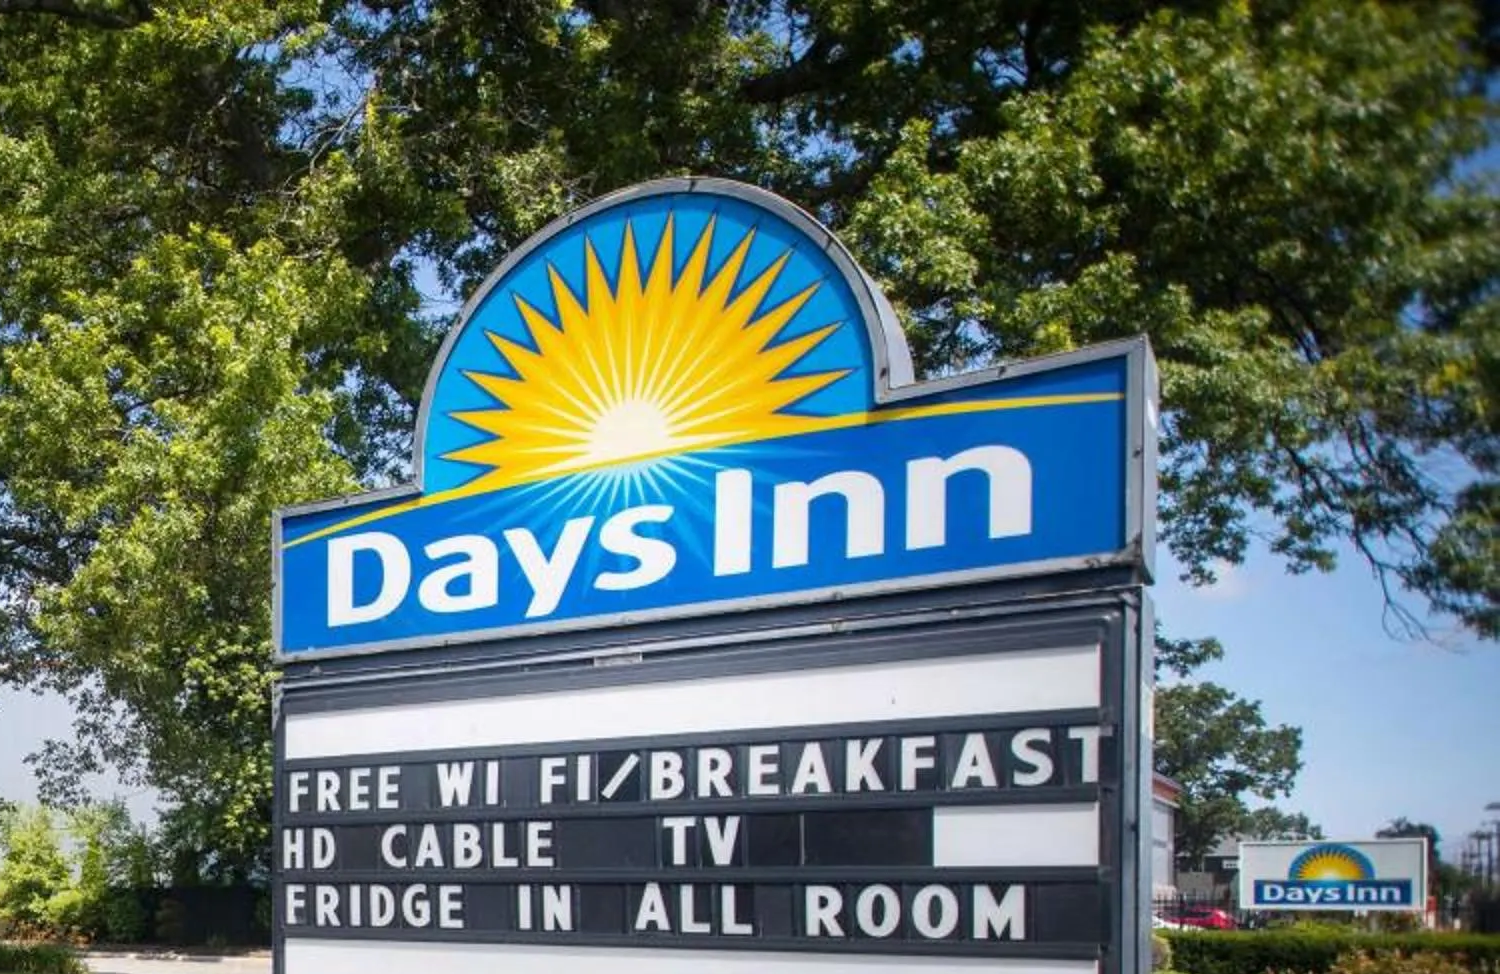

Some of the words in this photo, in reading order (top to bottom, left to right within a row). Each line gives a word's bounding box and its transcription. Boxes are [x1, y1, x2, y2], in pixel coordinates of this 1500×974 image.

[327, 505, 677, 627] Days
[714, 445, 1033, 577] Inn
[289, 764, 401, 813] FREE
[438, 758, 499, 807] WI
[285, 828, 337, 869] HD
[381, 821, 555, 869] CABLE
[663, 815, 742, 866] TV
[286, 883, 466, 929] FRIDGE
[520, 884, 574, 932] IN
[636, 884, 754, 936] ALL
[807, 884, 1027, 941] ROOM
[1263, 884, 1341, 904] Days
[1348, 883, 1401, 902] Inn
